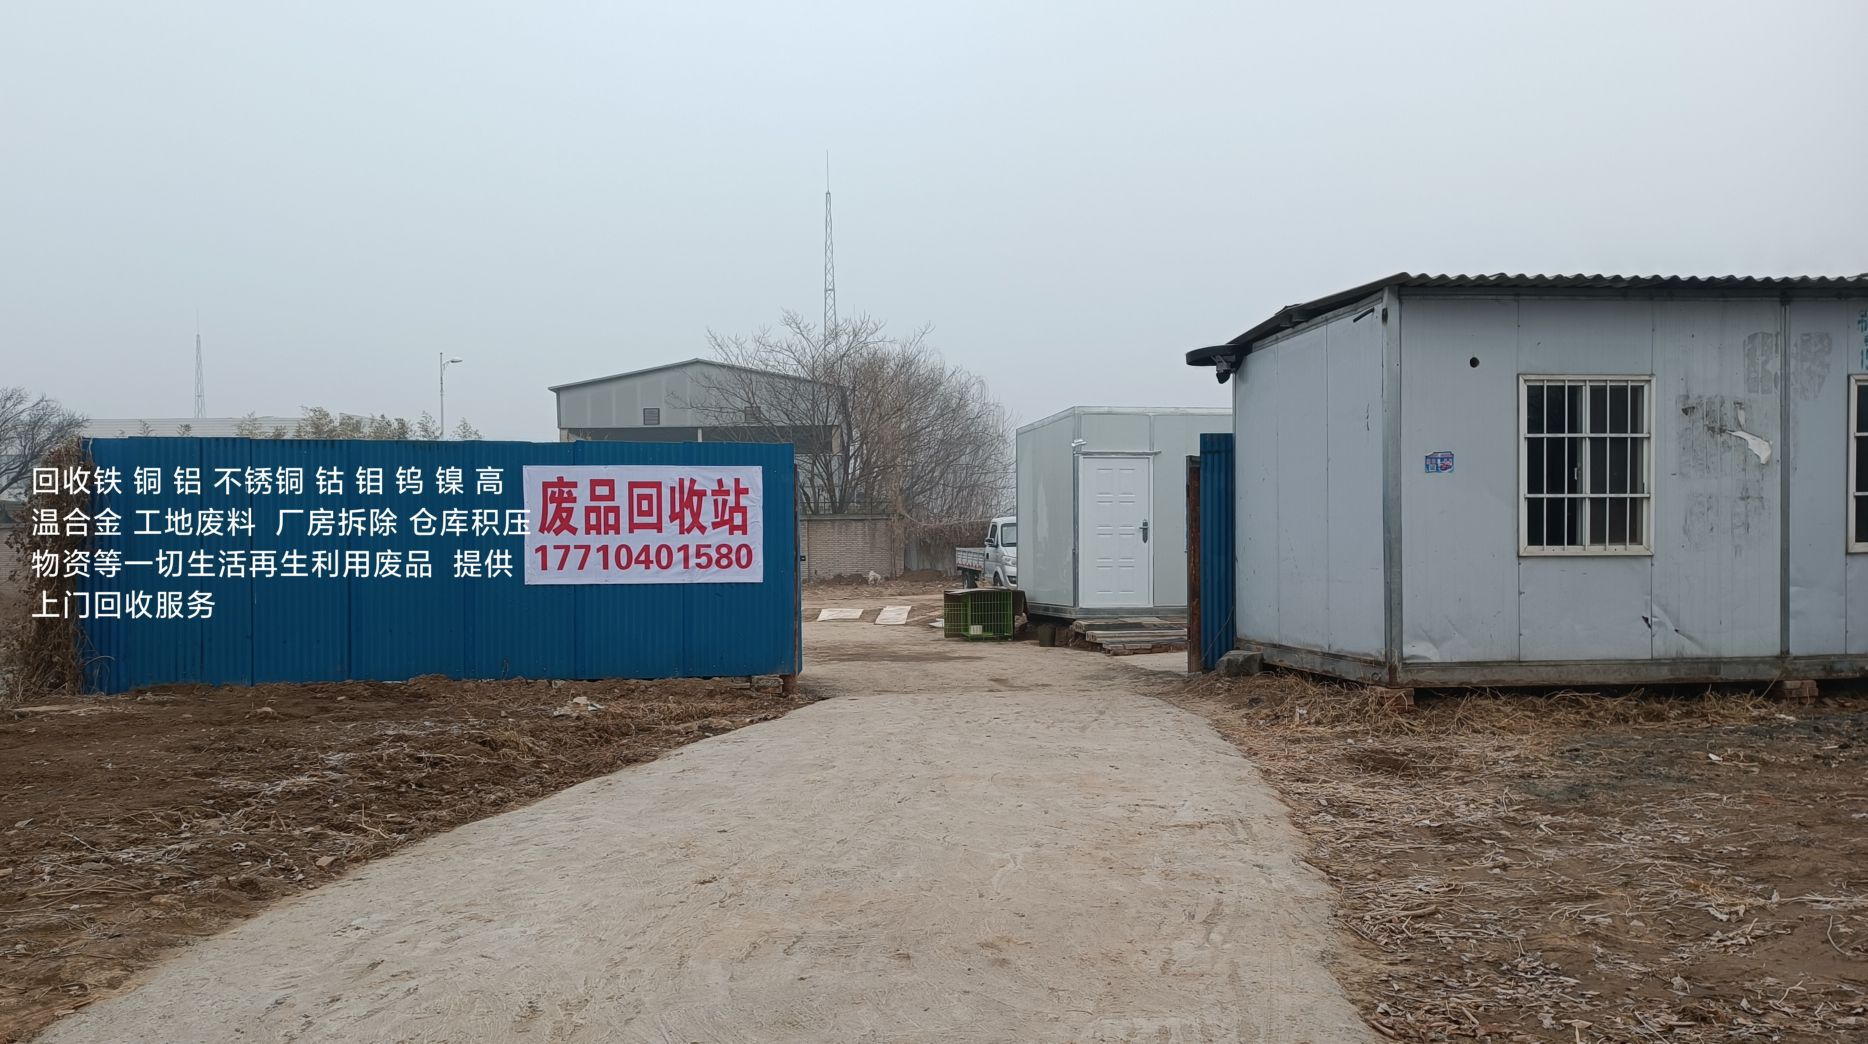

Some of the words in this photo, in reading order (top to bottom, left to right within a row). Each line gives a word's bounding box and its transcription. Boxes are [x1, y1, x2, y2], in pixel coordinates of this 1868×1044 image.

[538, 476, 749, 536] 废品回收站
[534, 543, 753, 571] 17710401580
